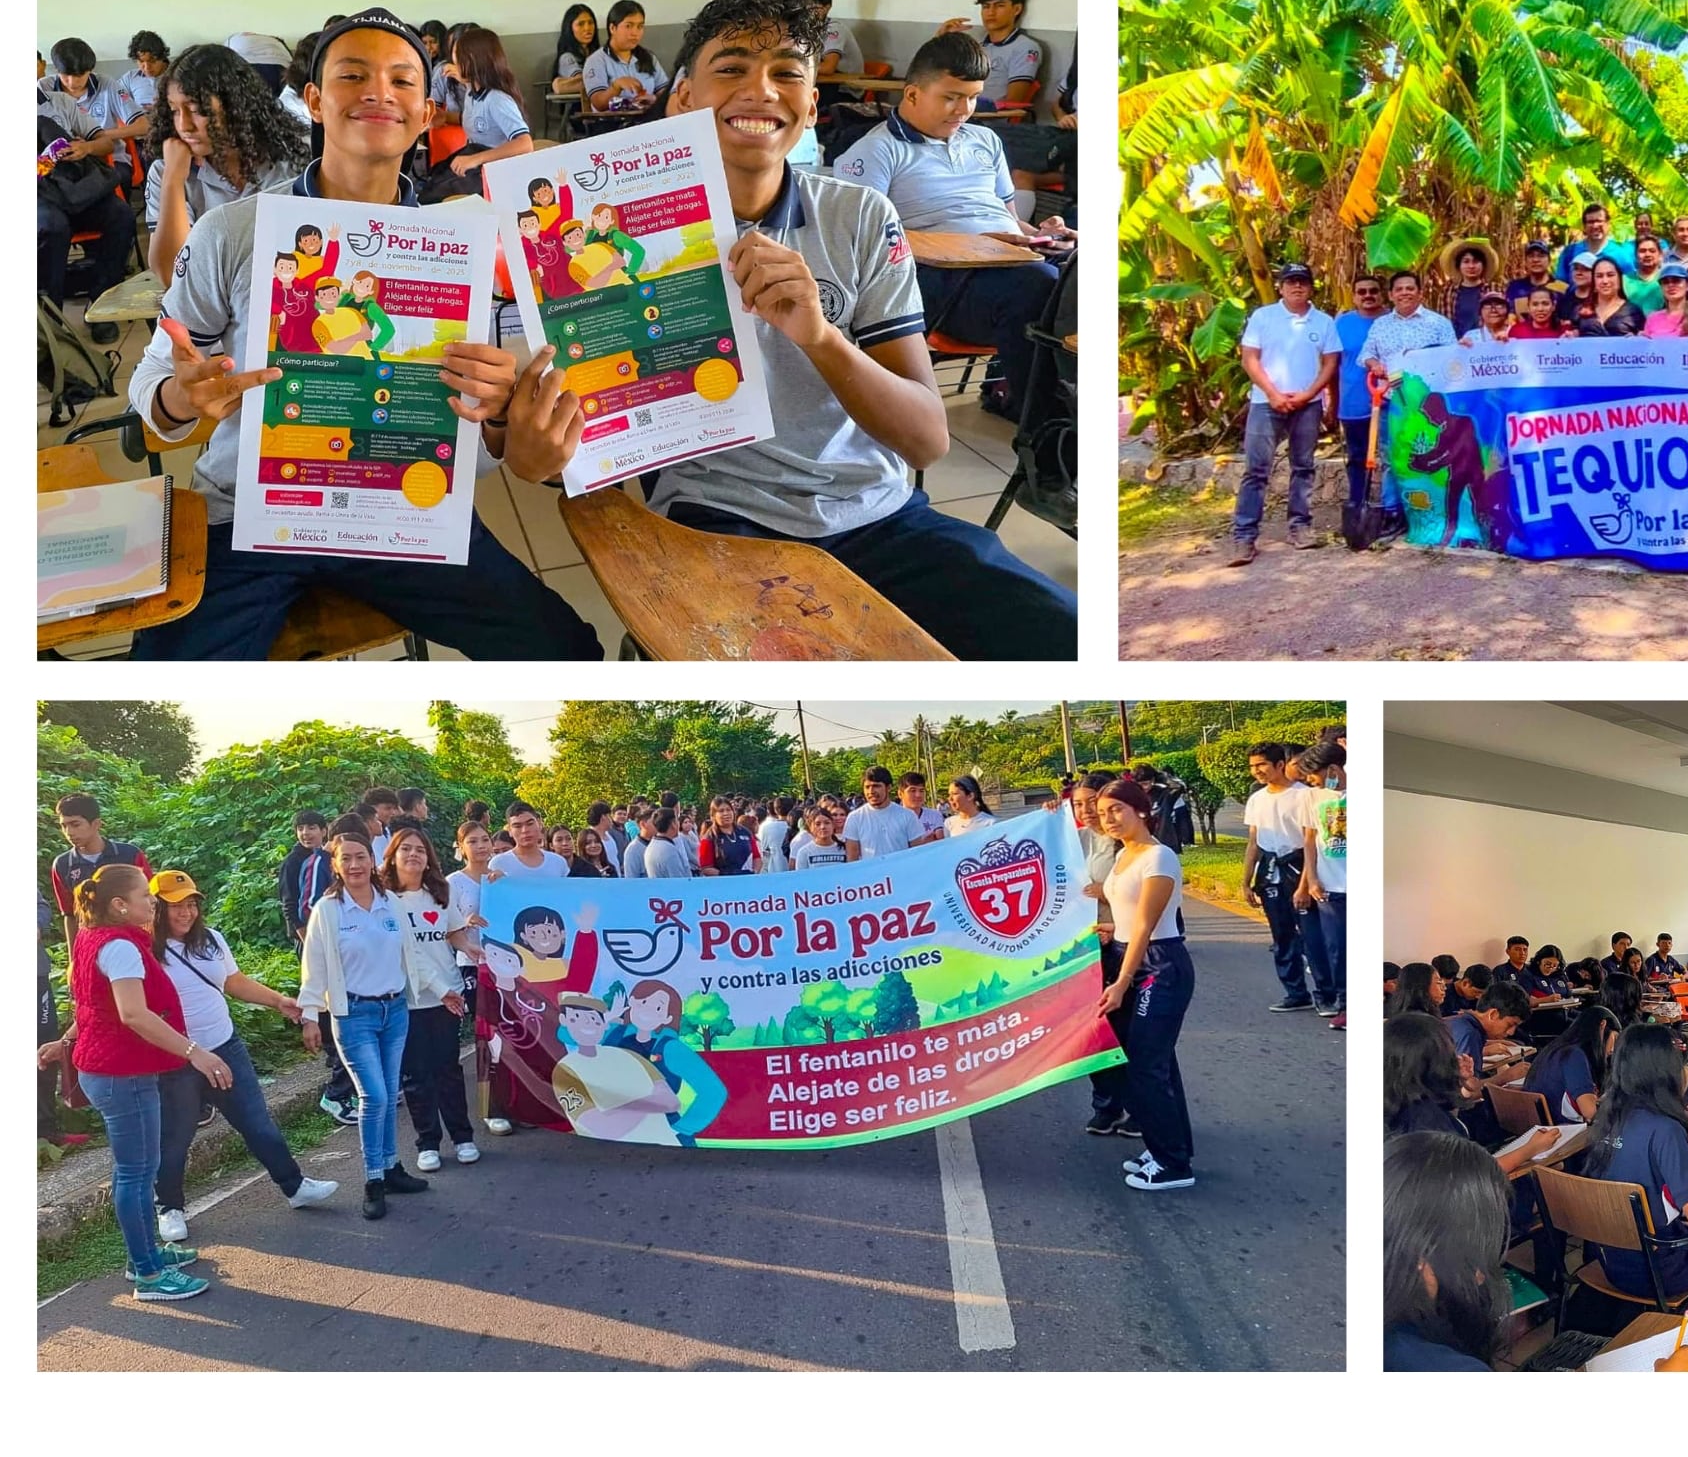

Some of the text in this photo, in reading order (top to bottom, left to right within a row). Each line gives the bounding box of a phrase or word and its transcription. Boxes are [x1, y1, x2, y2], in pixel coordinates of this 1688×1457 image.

[612, 145, 692, 175] Por la paz
[388, 223, 455, 236] Jornada Nacional
[387, 234, 469, 256] Por la paz
[392, 252, 468, 265] contra las adicciones
[394, 281, 429, 292] fentanilo
[302, 358, 340, 369] participar?
[1470, 361, 1520, 379] México
[1536, 353, 1583, 367] Trabajo
[1599, 352, 1665, 367] Educación
[1507, 405, 1603, 448] JORNADA
[1635, 510, 1666, 532] Por
[293, 532, 328, 542] México
[337, 531, 378, 543] Educación
[698, 877, 893, 917] Jornada Nacional
[943, 863, 1067, 953] UNIVERSIDAD AUTONOMA DE GUERRERO
[980, 879, 1034, 924] 37
[699, 901, 937, 961] Por la paz
[700, 949, 943, 995] y contra las adicciones
[1137, 988, 1151, 1018] UAGro
[766, 1010, 1029, 1076] El fentanilo te mata.
[767, 1024, 1052, 1105] Alejate de las drogas.
[769, 1087, 958, 1135] Elige ser feliz.
